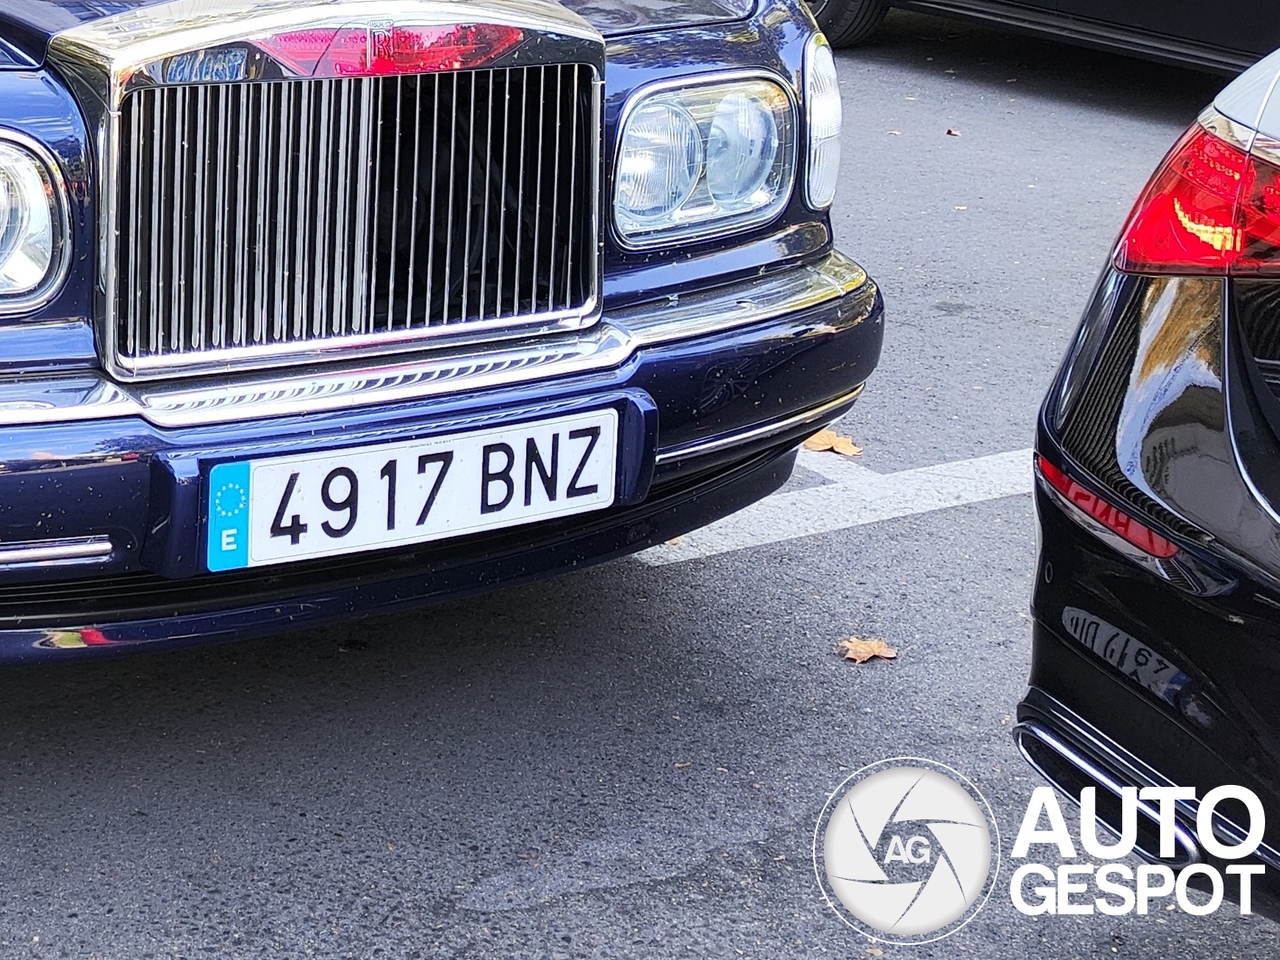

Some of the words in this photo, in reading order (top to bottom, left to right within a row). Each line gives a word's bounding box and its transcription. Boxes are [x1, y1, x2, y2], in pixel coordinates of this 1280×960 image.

[270, 451, 454, 545] 4917
[480, 425, 601, 516] BNZ
[221, 529, 238, 552] E
